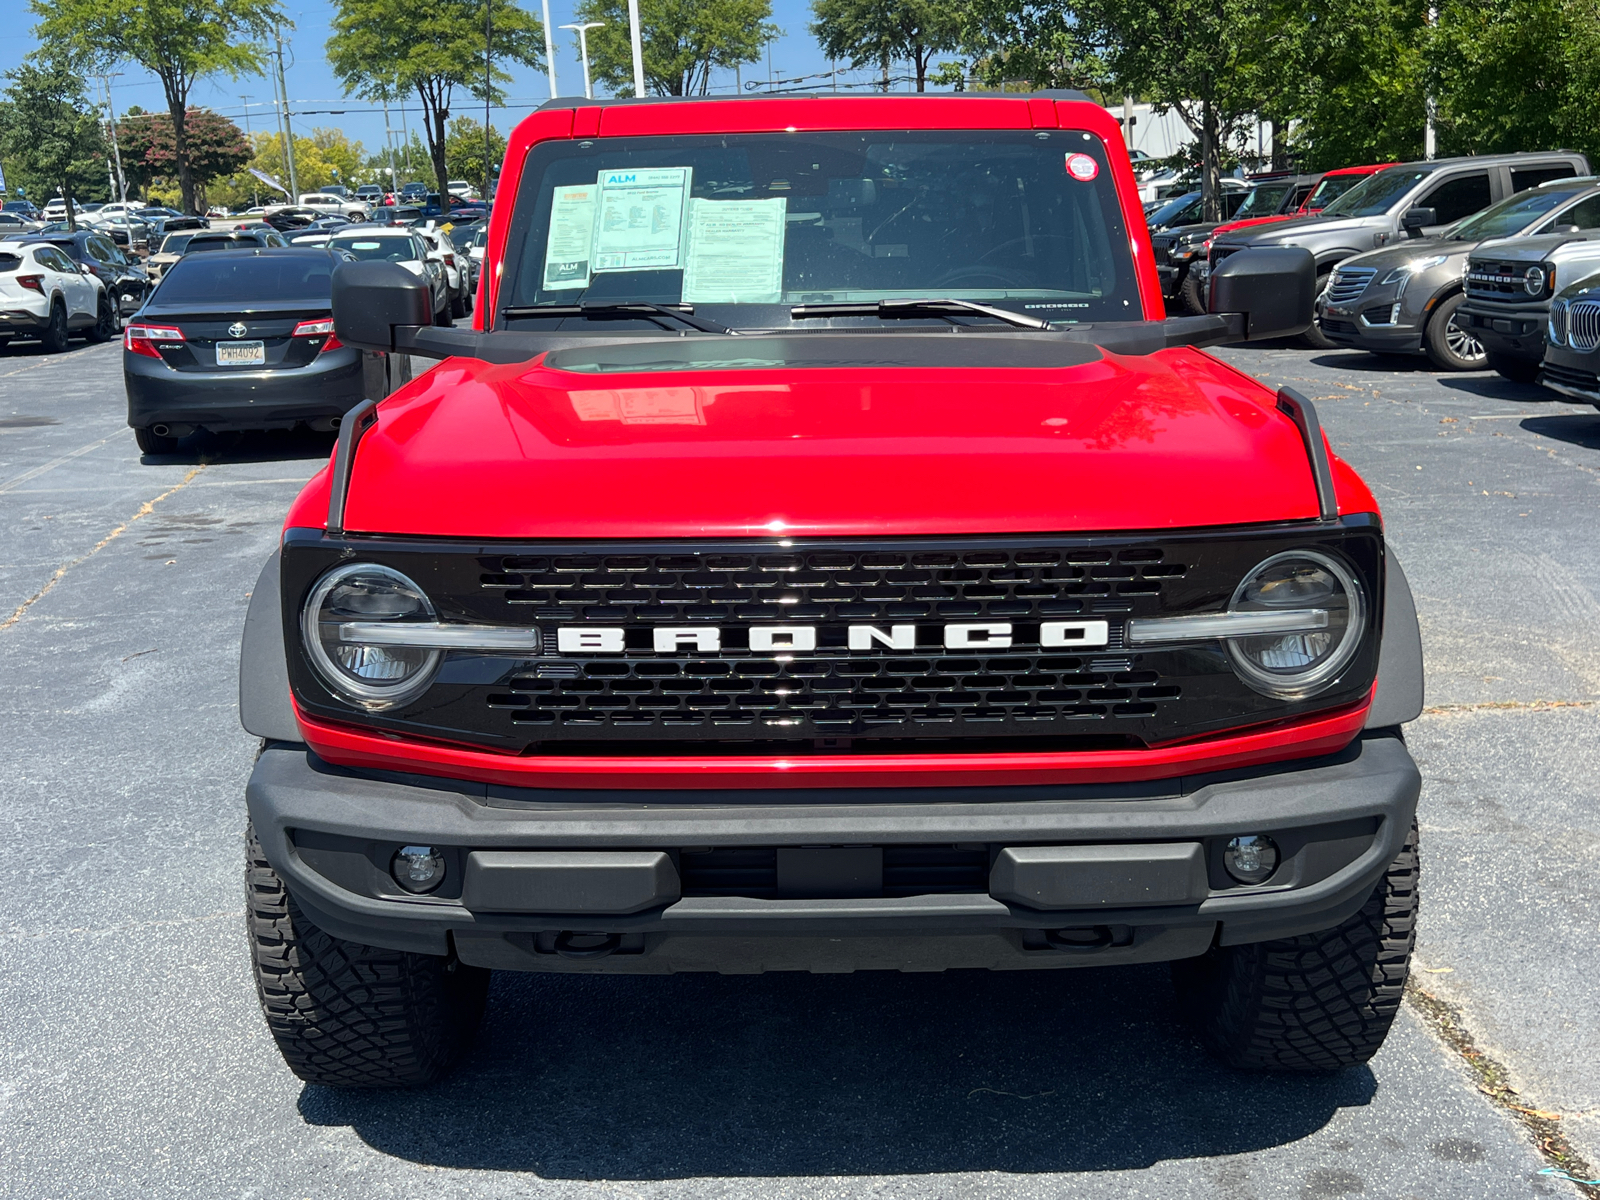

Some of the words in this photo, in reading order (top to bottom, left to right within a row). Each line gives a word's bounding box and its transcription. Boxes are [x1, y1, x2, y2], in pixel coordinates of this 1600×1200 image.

[608, 175, 636, 183] ALM
[560, 263, 578, 271] ALM
[221, 346, 259, 359] PWH4092
[558, 620, 1108, 652] BRONCO
